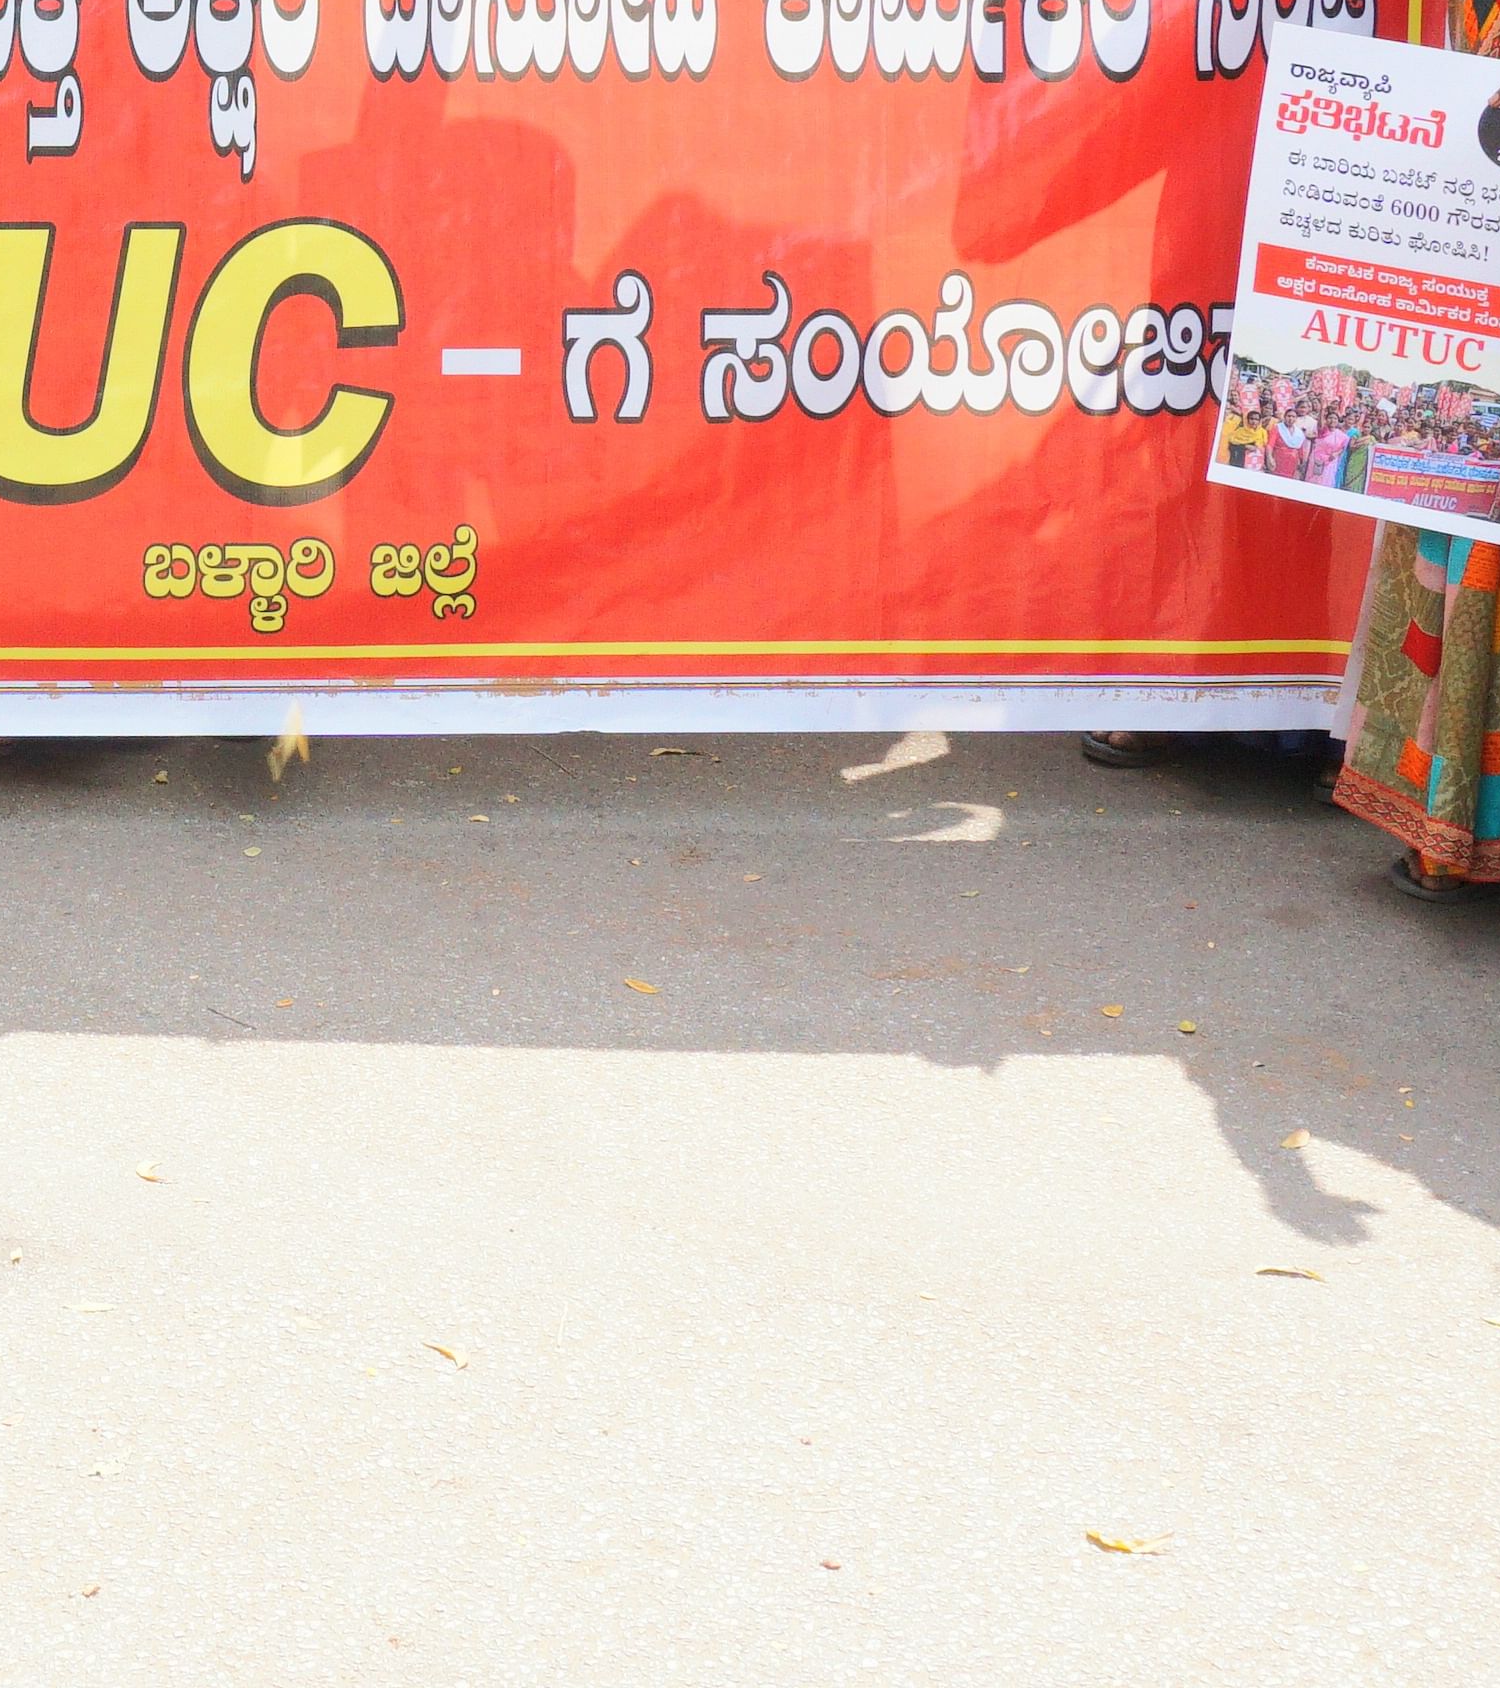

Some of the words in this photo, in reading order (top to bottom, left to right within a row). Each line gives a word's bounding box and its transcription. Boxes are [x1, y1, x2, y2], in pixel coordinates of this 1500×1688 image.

[1289, 61, 1393, 101] ರಾಜ್ಯವ್ಯಾಪಿ
[1276, 88, 1447, 150] ಪ್ರತಿಭಟನೆ
[1282, 178, 1385, 213] ನೀಡಿರುವಂತೆ
[1390, 198, 1441, 223] 6000
[1288, 148, 1307, 166] ಈ
[1312, 155, 1376, 180] ಬಾರಿಯ
[1382, 167, 1439, 190] ಬಜೆಟ್
[1442, 178, 1476, 206] ನಲ್ಲಿ
[1279, 208, 1343, 239] ಹೆಚ್ಚಳದ
[1348, 223, 1402, 247] ಕುರಿತು
[1277, 274, 1316, 297] ಅಕ್ಷರ
[1319, 285, 1393, 308] ದಾಸೋಹ
[1395, 299, 1472, 323] ಕಾರ್ಮಿಕರ
[1305, 256, 1375, 281] ಕರ್ನಾಟಕ
[1377, 272, 1418, 295] ರಾಜ್ಯ
[1421, 279, 1490, 307] ಸಂಯುಕ್ತ
[562, 269, 655, 423] ಗೆ
[1301, 309, 1485, 372] AIUTUC
[143, 536, 336, 634] ಬಳ್ಳಾರಿ
[370, 523, 479, 620] ಜಿಲ್ಲೆ
